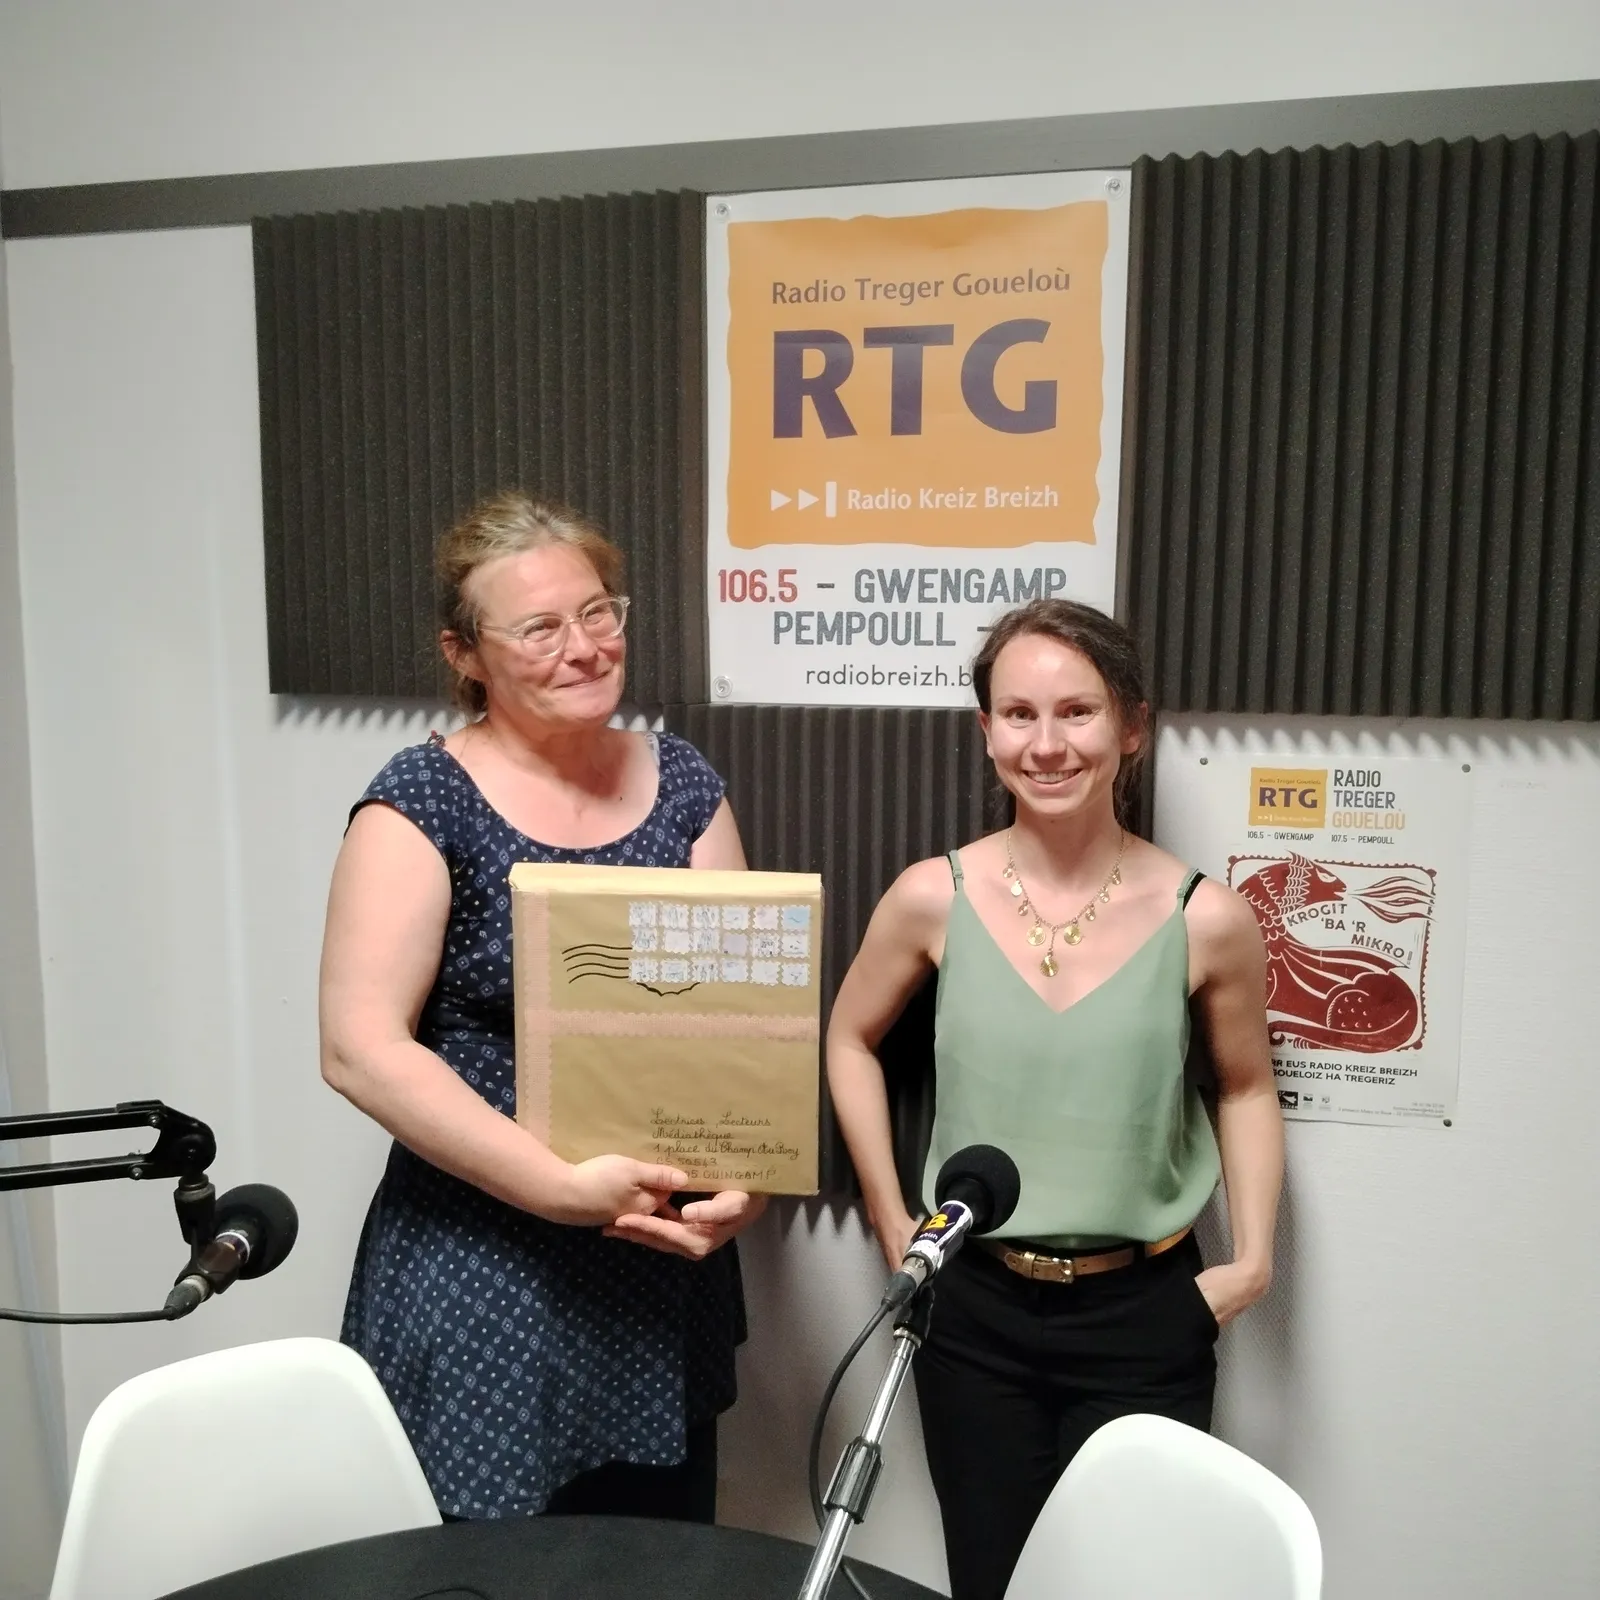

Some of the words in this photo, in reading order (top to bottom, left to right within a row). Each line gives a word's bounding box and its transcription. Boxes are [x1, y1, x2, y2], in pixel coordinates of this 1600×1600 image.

[772, 279, 846, 304] Radio
[855, 276, 944, 305] Treger
[952, 268, 1071, 297] Goueloù
[773, 318, 1058, 439] RTG
[847, 488, 911, 510] Radio
[919, 487, 977, 509] Kreiz
[984, 485, 1059, 508] Breizh
[718, 569, 798, 603] 106.5
[854, 568, 1067, 603] GWENGAMP
[773, 611, 956, 646] PEMPOULL
[806, 664, 973, 688] radiobreizh.b
[1333, 769, 1382, 787] RADIO
[1259, 786, 1318, 809] RTG
[1333, 790, 1396, 809] TREGER
[1247, 831, 1264, 840] 106.5
[1274, 831, 1315, 842] GWENGAMP
[1331, 834, 1348, 843] 107.5
[1357, 835, 1395, 845] PEMPOULL
[1286, 902, 1348, 927] KROGIT
[1286, 1060, 1307, 1069] EUS
[1309, 1061, 1343, 1071] RADIO
[1345, 1064, 1376, 1074] KREIZ
[1379, 1067, 1418, 1077] BREIZH
[1325, 1072, 1341, 1081] HA
[1345, 1074, 1396, 1086] TREGERIZ
[652, 1127, 734, 1146] Médiathèque
[664, 1140, 700, 1156] place
[705, 1142, 718, 1153] du
[719, 1141, 757, 1159] Champ
